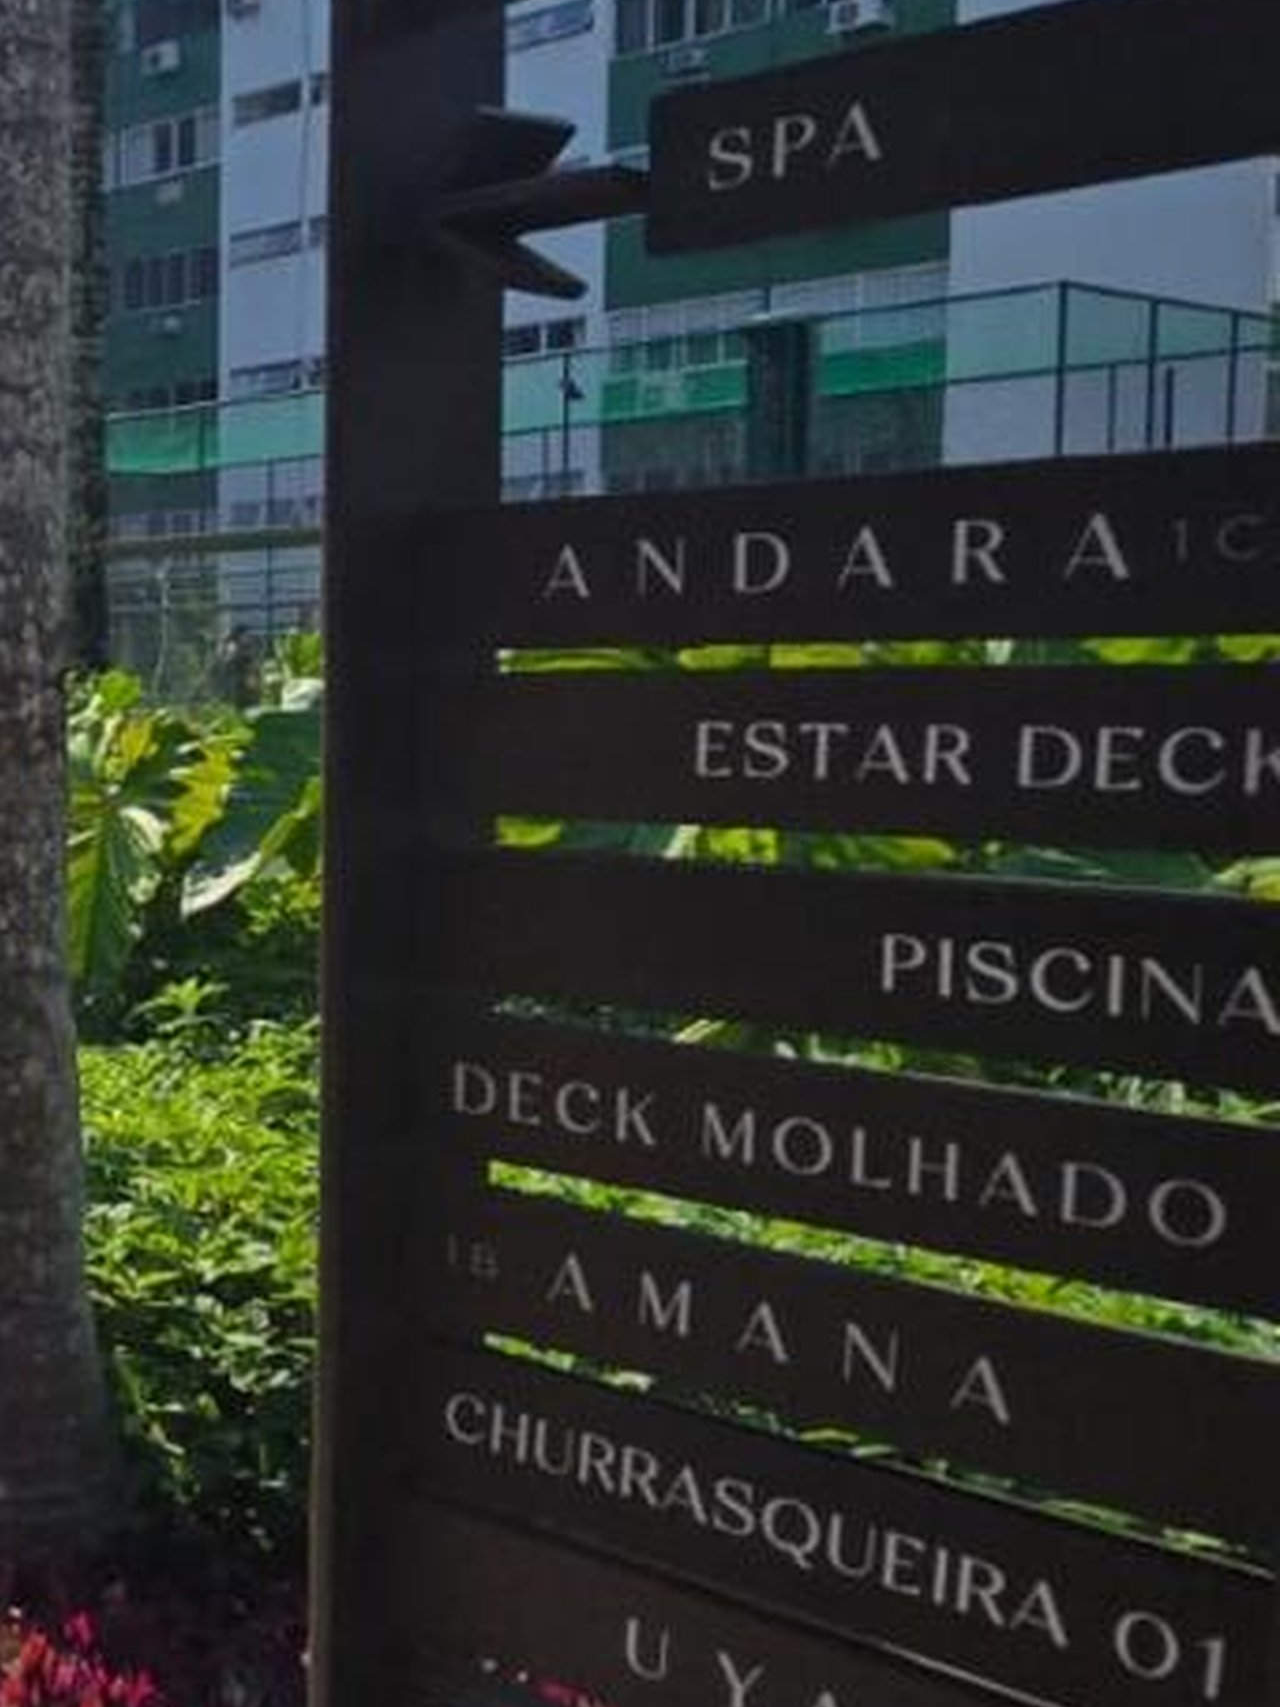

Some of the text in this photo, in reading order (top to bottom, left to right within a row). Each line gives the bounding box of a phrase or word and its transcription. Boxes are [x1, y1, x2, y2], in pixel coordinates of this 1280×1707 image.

[707, 104, 883, 190] SPA
[544, 513, 1130, 598] ANDARA
[694, 721, 972, 785] ESTAR
[880, 933, 1280, 1034] PISCINA
[452, 1063, 1227, 1247] DECK MOLHADO
[546, 1254, 1012, 1427] AMANA
[445, 1392, 1227, 1699] CHURRASQUEIRA 01
